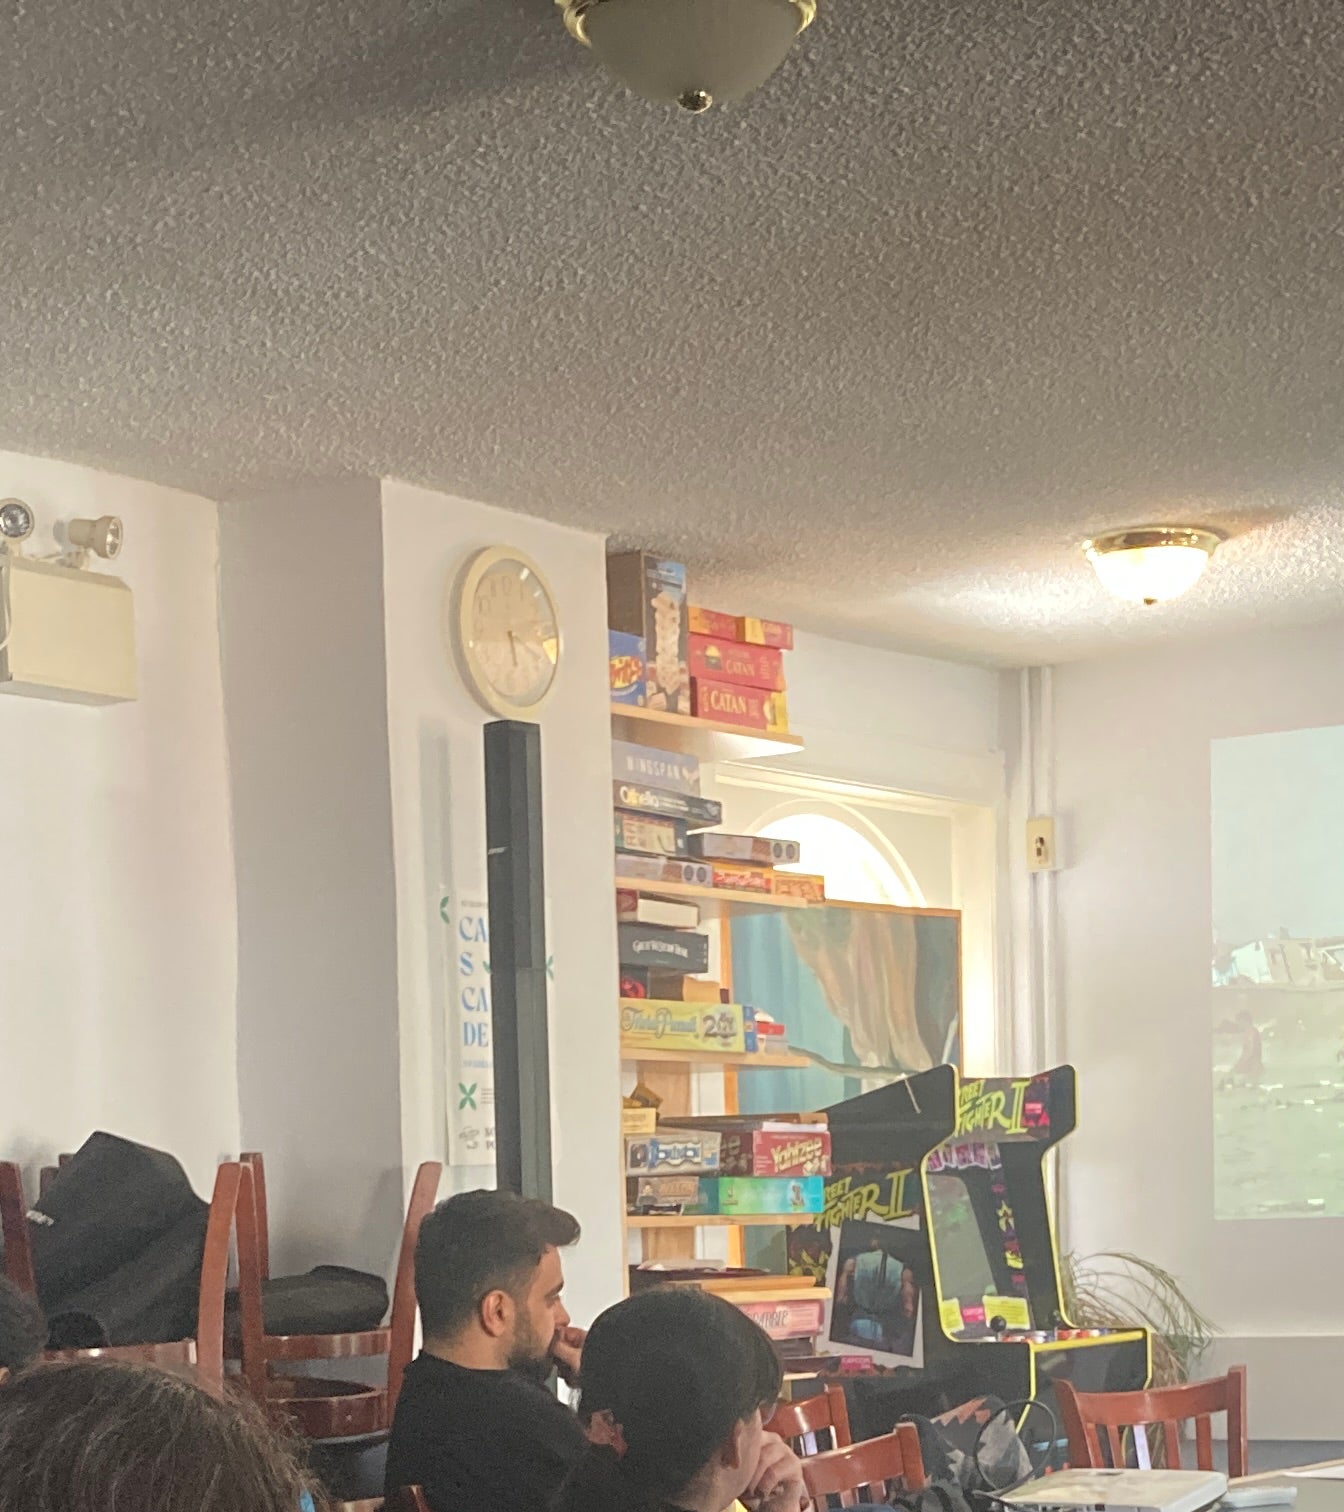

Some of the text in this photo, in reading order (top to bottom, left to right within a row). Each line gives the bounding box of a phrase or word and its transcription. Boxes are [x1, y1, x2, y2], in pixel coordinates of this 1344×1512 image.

[725, 659, 755, 677] CATAN
[710, 690, 747, 714] CATAN
[463, 1021, 489, 1048] DE
[770, 1137, 823, 1173] Yahtzee
